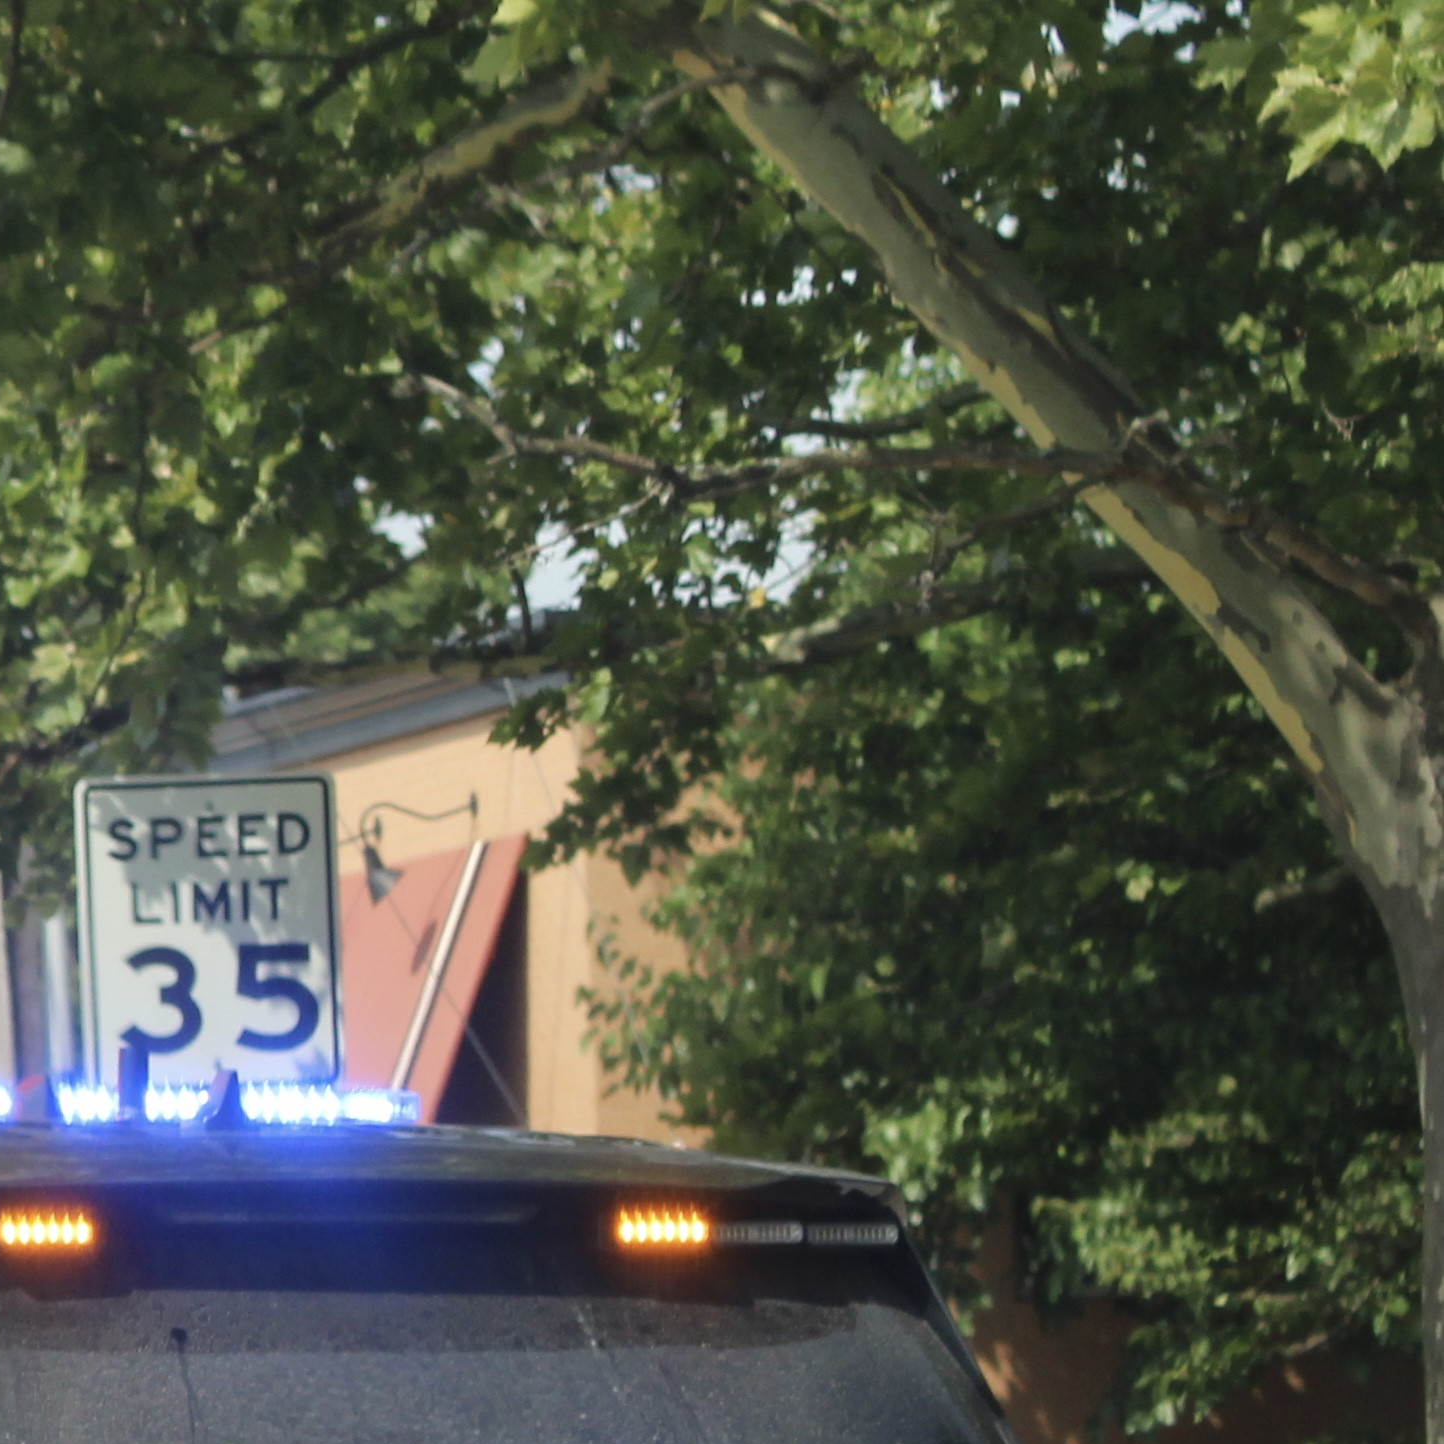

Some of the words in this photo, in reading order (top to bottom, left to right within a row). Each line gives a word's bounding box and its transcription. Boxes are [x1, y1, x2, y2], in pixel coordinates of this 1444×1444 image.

[108, 813, 311, 861] SPEED
[132, 878, 290, 924] LIMIT
[120, 943, 320, 1054] 35
